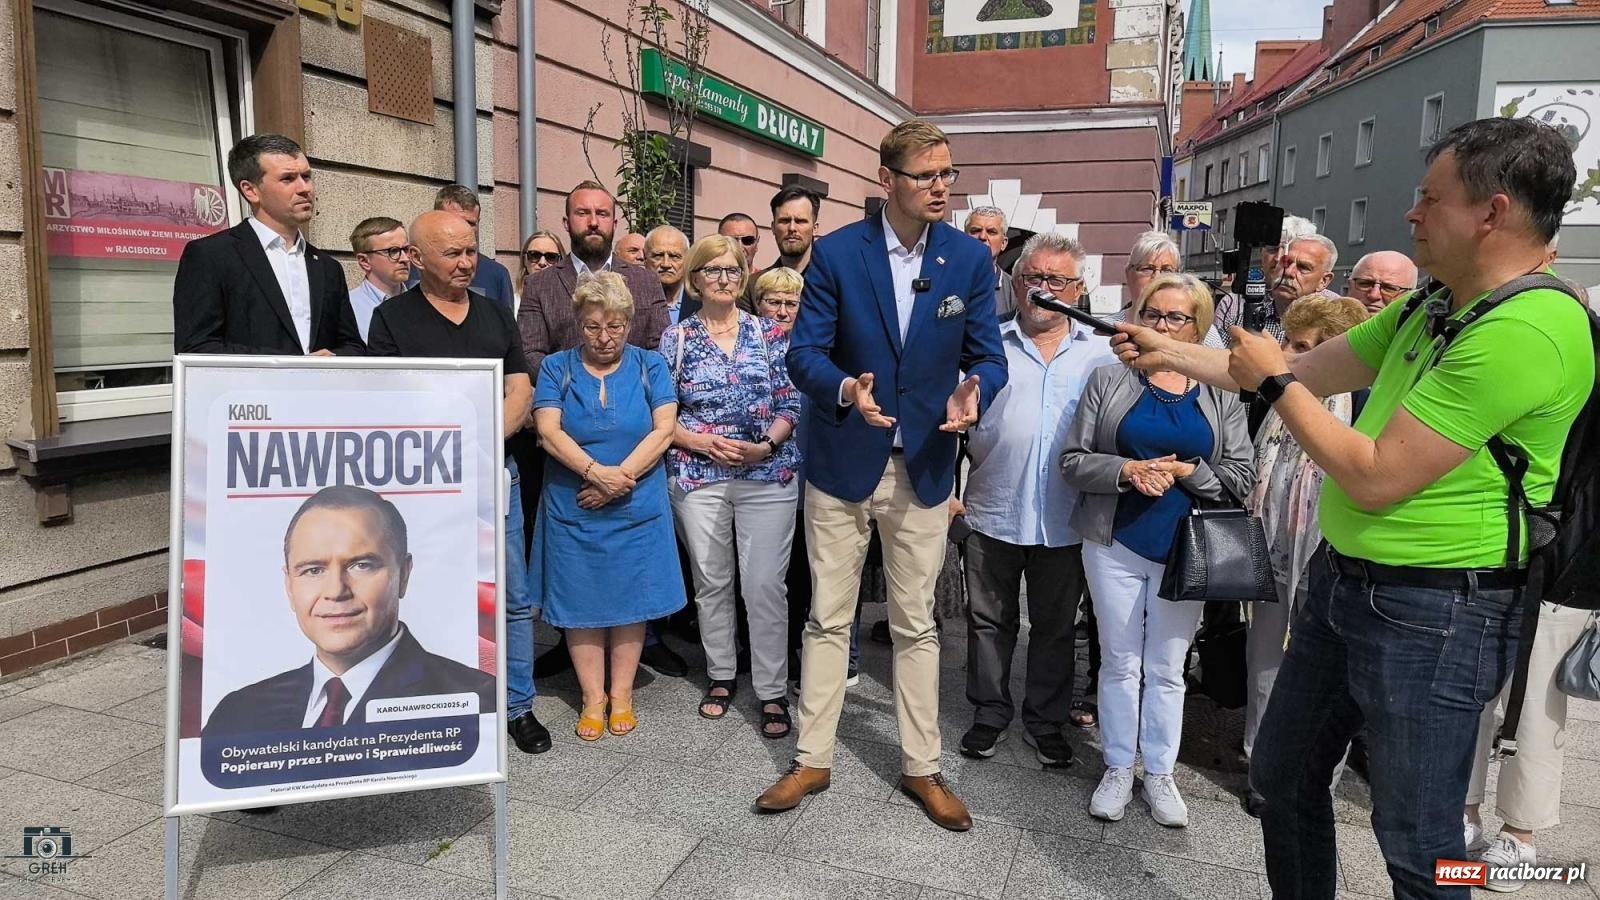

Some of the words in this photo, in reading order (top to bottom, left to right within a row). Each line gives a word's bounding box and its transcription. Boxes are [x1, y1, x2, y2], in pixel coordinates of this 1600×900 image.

[757, 103, 809, 150] DŁUGA
[811, 129, 820, 151] 7
[97, 226, 149, 238] MIŁOŚNIKÓW
[152, 230, 173, 239] ZIEMI
[115, 245, 167, 256] RACIBORZU
[228, 404, 272, 421] KAROL
[226, 430, 462, 489] NAWROCKI
[376, 701, 469, 714] KAROLNAWROCKI2025.pl
[221, 741, 300, 759] Obywatelski
[303, 736, 359, 751] kandydat
[361, 737, 376, 745] na
[379, 730, 443, 744] Prezydenta
[445, 727, 461, 738] RP
[220, 760, 286, 774] Popierany
[288, 755, 322, 769] przez
[325, 751, 363, 763] Prawo
[372, 741, 463, 760] Sprawiedliwość
